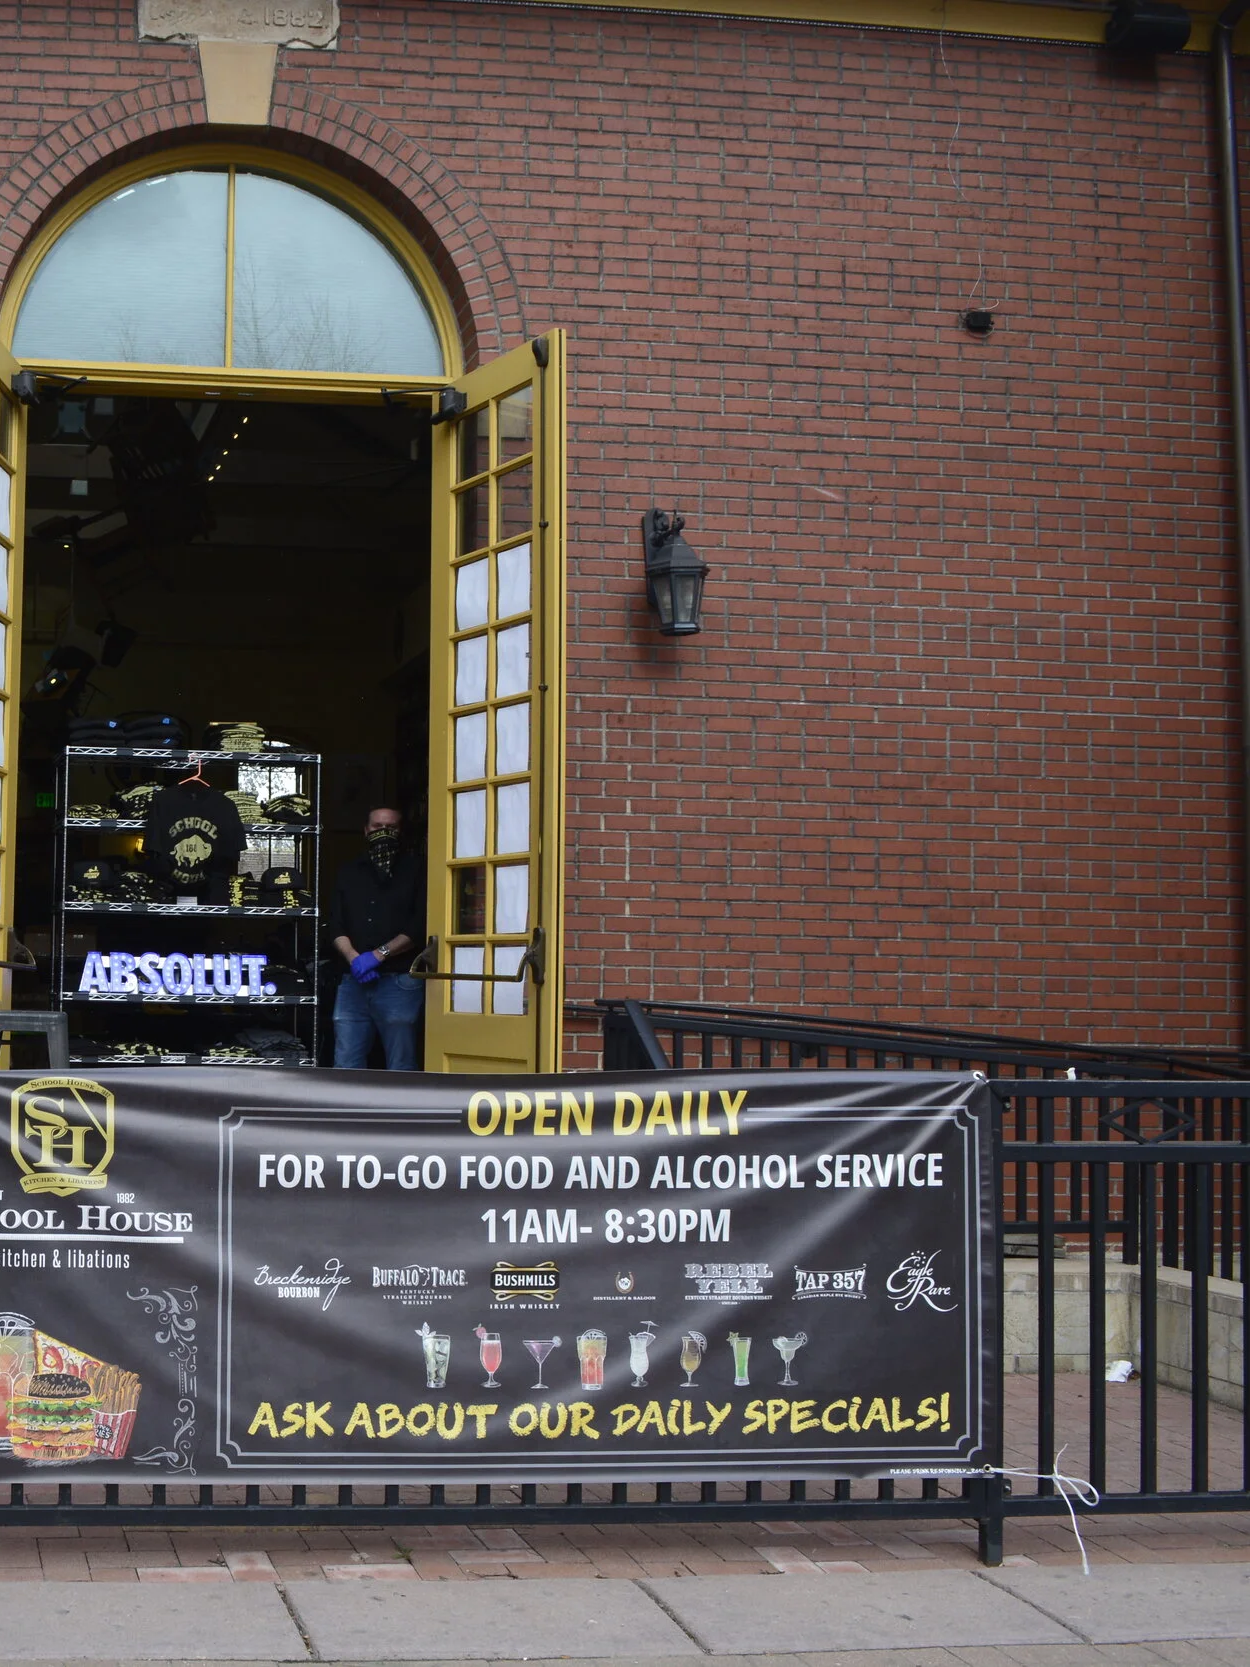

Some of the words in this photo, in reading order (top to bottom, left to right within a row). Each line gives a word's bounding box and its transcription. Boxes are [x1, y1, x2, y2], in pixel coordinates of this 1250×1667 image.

[168, 816, 218, 840] SCHOOL
[467, 1090, 596, 1137] OPEN
[613, 1089, 748, 1137] DAILY
[24, 1096, 94, 1168] SH
[23, 1176, 57, 1187] KITCHEN
[258, 1153, 326, 1189] FOR
[336, 1154, 448, 1190] TO-GO
[459, 1155, 555, 1190] FOOD
[564, 1155, 641, 1190] AND
[649, 1154, 806, 1190] ALCOHOL
[815, 1153, 944, 1188] SERVICE
[116, 1192, 136, 1204] 1882
[480, 1208, 593, 1244] 11AM-
[604, 1207, 732, 1244] 8:30PM
[52, 1250, 62, 1269] &
[67, 1249, 131, 1269] libations
[684, 1262, 774, 1279] REBEL
[253, 1258, 352, 1311] Breckenridge
[372, 1265, 420, 1288] BUFFALO
[430, 1265, 466, 1287] TRACE
[494, 1273, 556, 1287] BUSHMILLS
[695, 1278, 764, 1294] YELL
[795, 1270, 830, 1293] TAP
[832, 1268, 867, 1292] 357
[886, 1249, 942, 1300] Eagle
[277, 1286, 321, 1299] BOURBON
[895, 1276, 959, 1313] Rare
[248, 1401, 336, 1439] ASK
[344, 1402, 499, 1440] ABOUT
[508, 1402, 601, 1440] OUR
